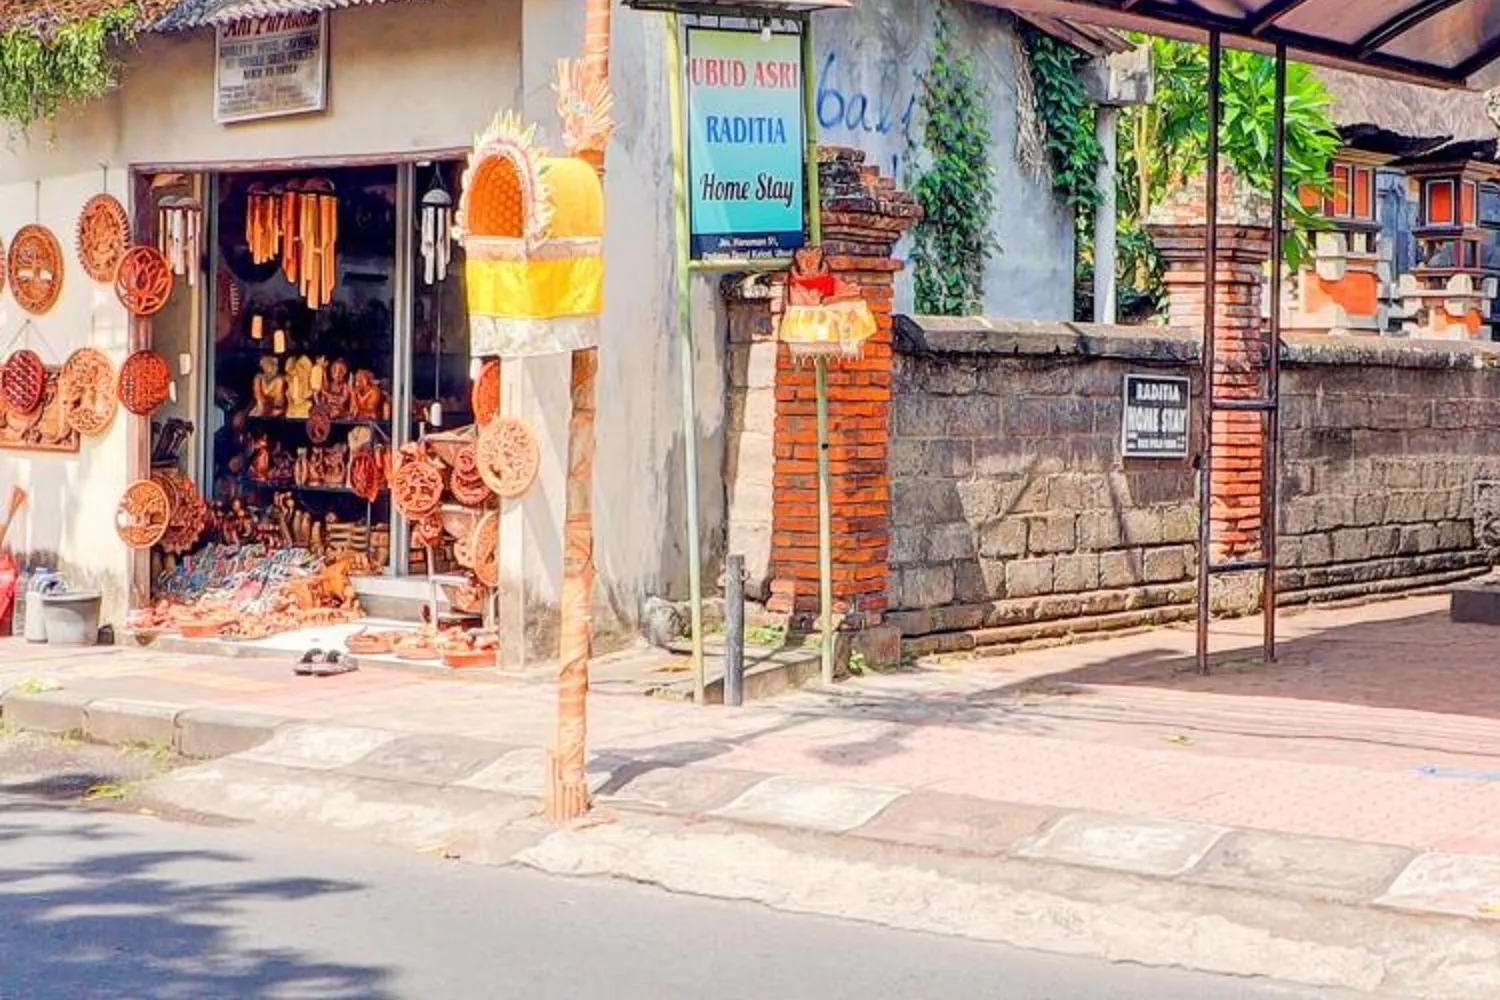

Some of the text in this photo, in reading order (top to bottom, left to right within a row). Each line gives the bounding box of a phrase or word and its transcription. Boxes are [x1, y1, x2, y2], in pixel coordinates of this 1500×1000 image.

[691, 58, 798, 90] UBUD ASRI
[706, 116, 787, 144] RADITIA
[701, 171, 795, 209] Home Stay
[1136, 383, 1181, 402] RADITIA
[1127, 406, 1187, 433] HOME STAY
